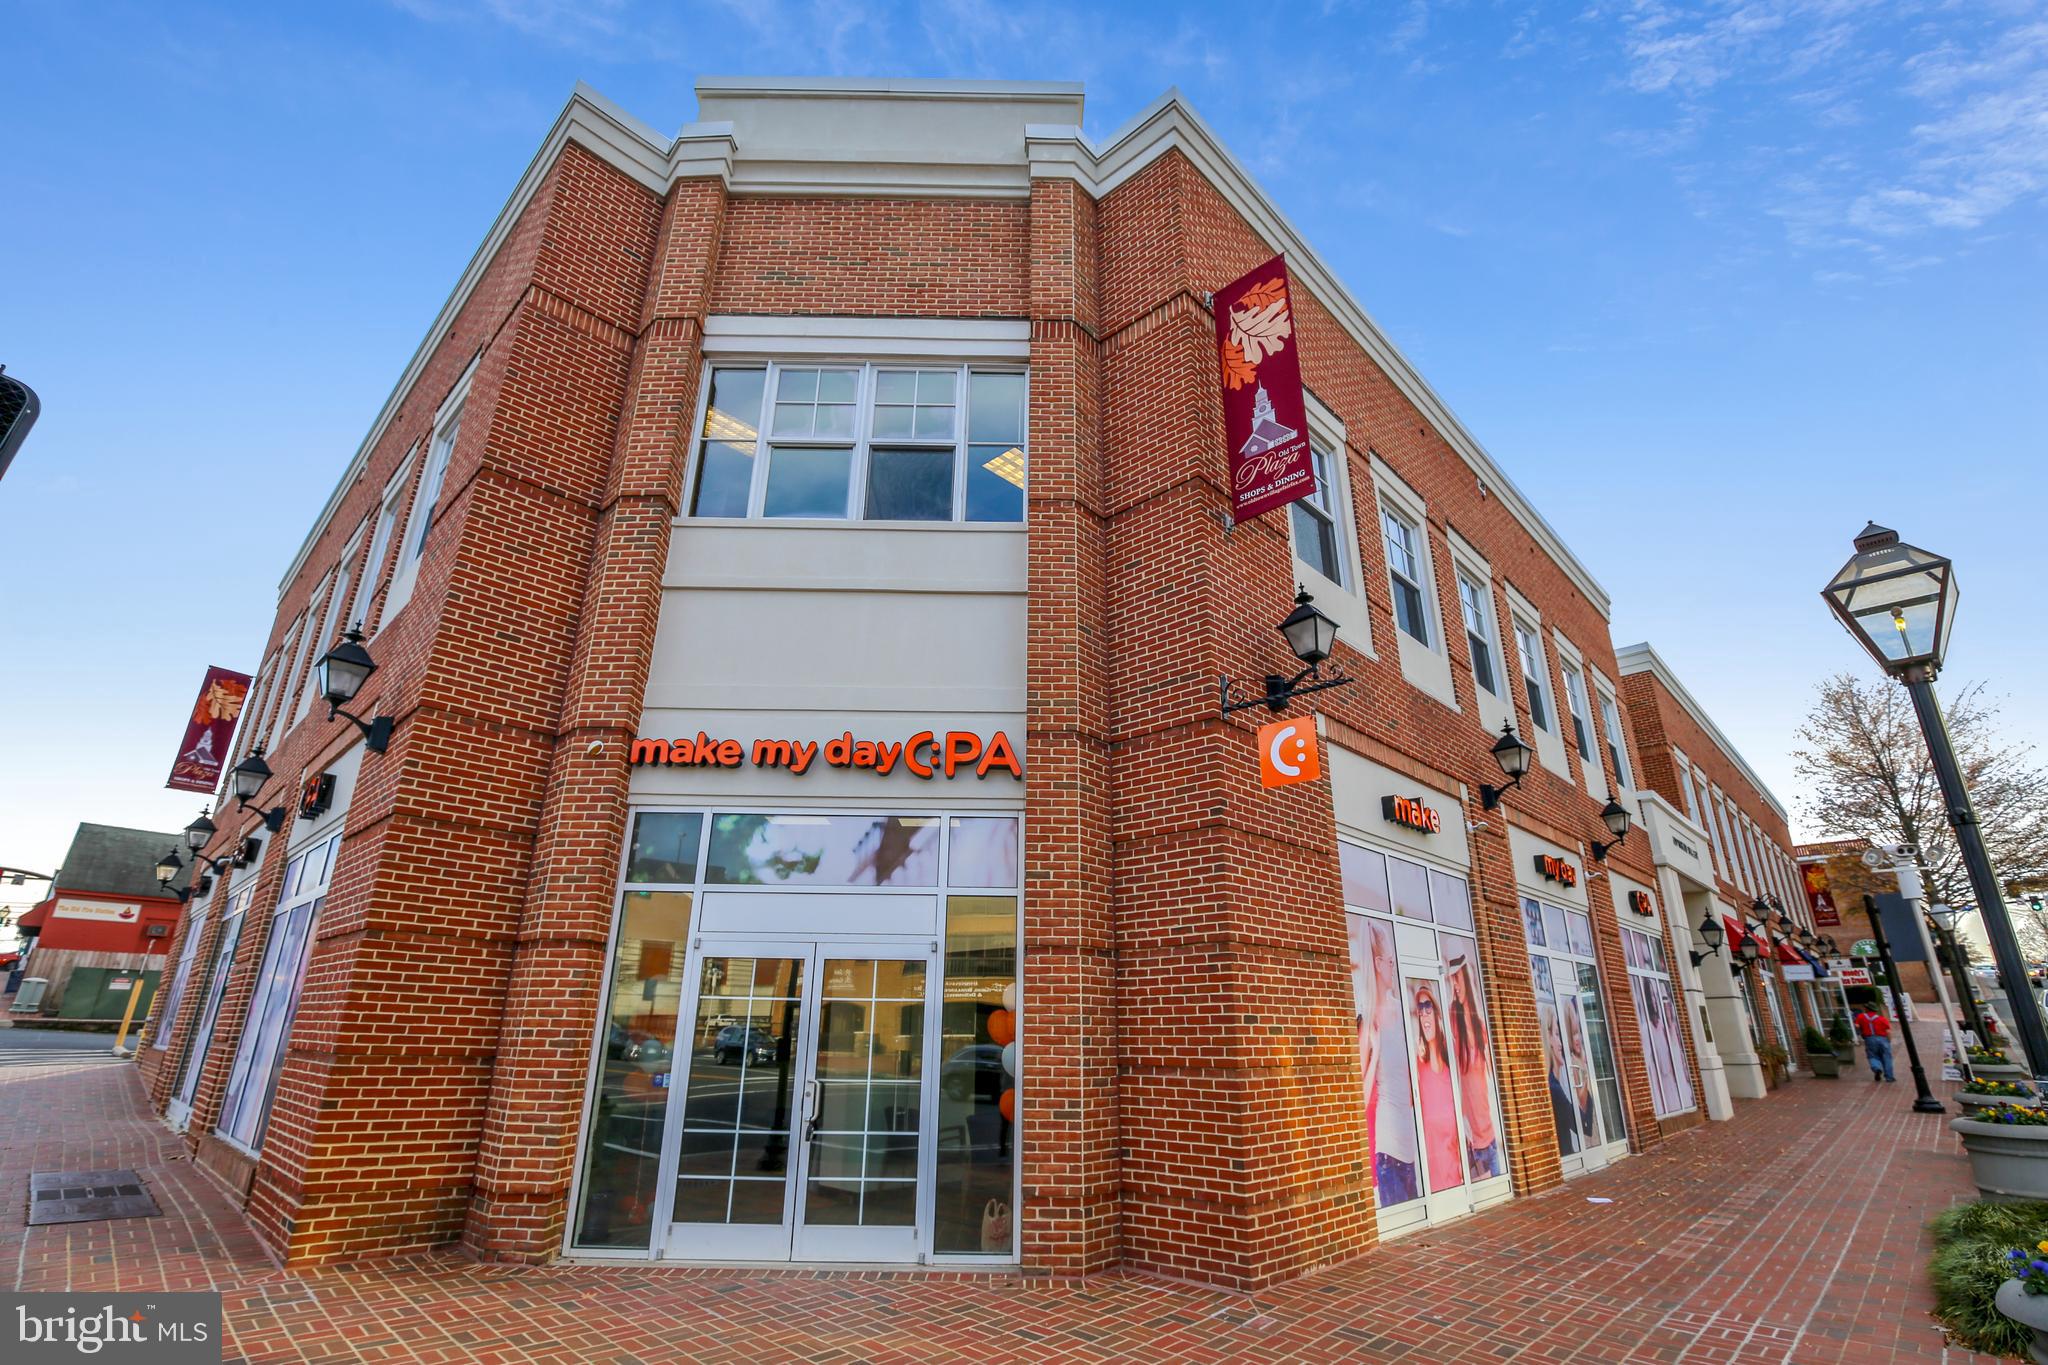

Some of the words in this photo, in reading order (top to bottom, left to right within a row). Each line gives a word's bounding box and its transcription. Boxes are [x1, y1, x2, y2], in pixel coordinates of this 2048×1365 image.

[1278, 447, 1290, 458] Old
[1290, 441, 1306, 453] Town
[1235, 450, 1300, 491] Plaza
[1239, 485, 1266, 502] SHOPS
[1267, 483, 1274, 491] &
[1275, 469, 1306, 488] DINING
[629, 731, 744, 767] make
[752, 739, 818, 776] my
[823, 731, 901, 777] day
[1393, 794, 1441, 834] make
[1544, 855, 1560, 881] my
